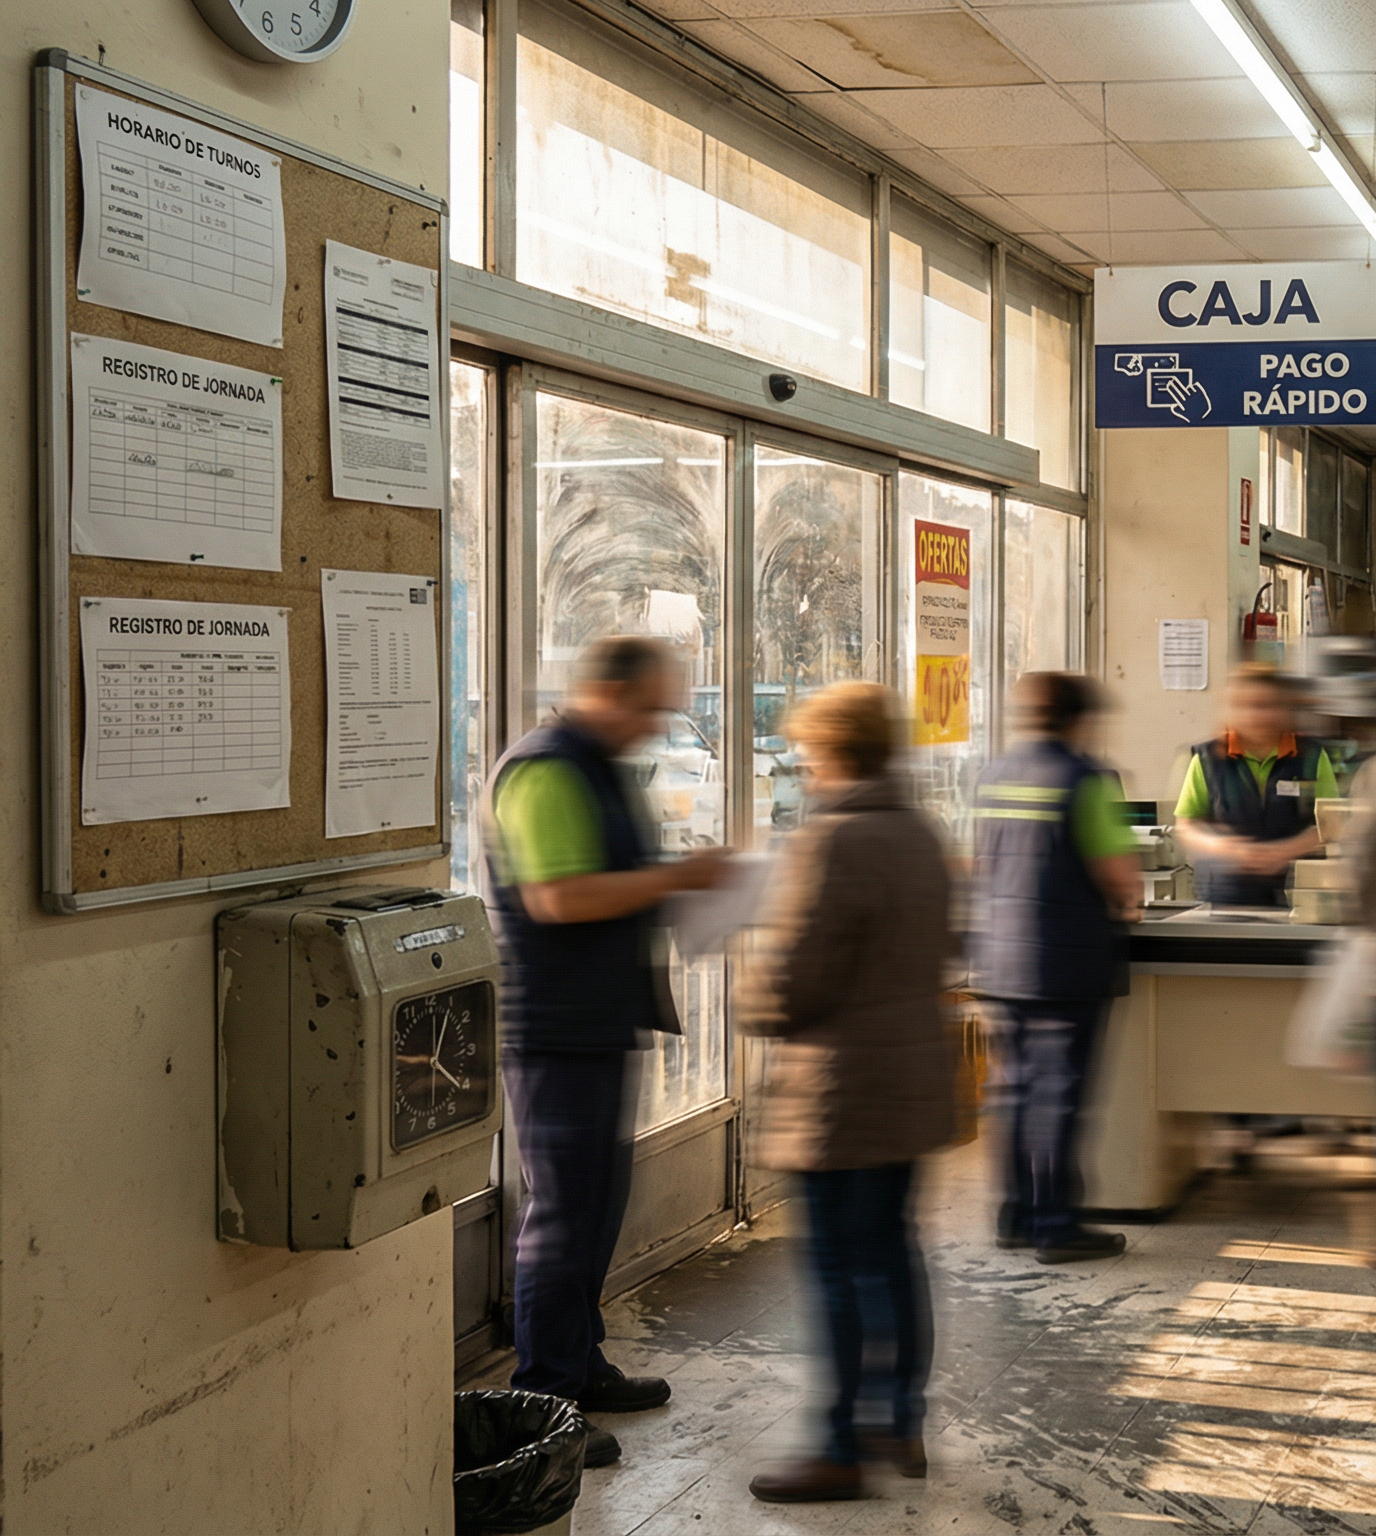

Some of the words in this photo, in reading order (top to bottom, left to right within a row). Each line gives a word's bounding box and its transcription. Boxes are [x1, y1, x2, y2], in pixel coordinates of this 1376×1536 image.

[262, 11, 274, 33] 6
[290, 12, 302, 36] 5
[108, 112, 181, 150] HORARIO
[185, 138, 204, 159] DE
[207, 146, 261, 179] TURNOS
[1158, 279, 1321, 328] CAJA
[1260, 352, 1350, 379] PAGO
[102, 356, 178, 386] REGISTRO
[182, 372, 200, 390] DE
[203, 377, 265, 404] JORNADA
[1243, 384, 1367, 416] RÁPIDO
[919, 530, 968, 577] OFERTAS
[109, 616, 183, 635] REGISTRO
[187, 620, 205, 635] DE
[208, 620, 270, 637] JORNADA
[461, 1010, 471, 1023] 2
[466, 1043, 476, 1056] 3
[461, 1077, 470, 1090] 4
[447, 1102, 456, 1115] 5
[408, 1117, 417, 1132] 7
[427, 1117, 437, 1129] 6
